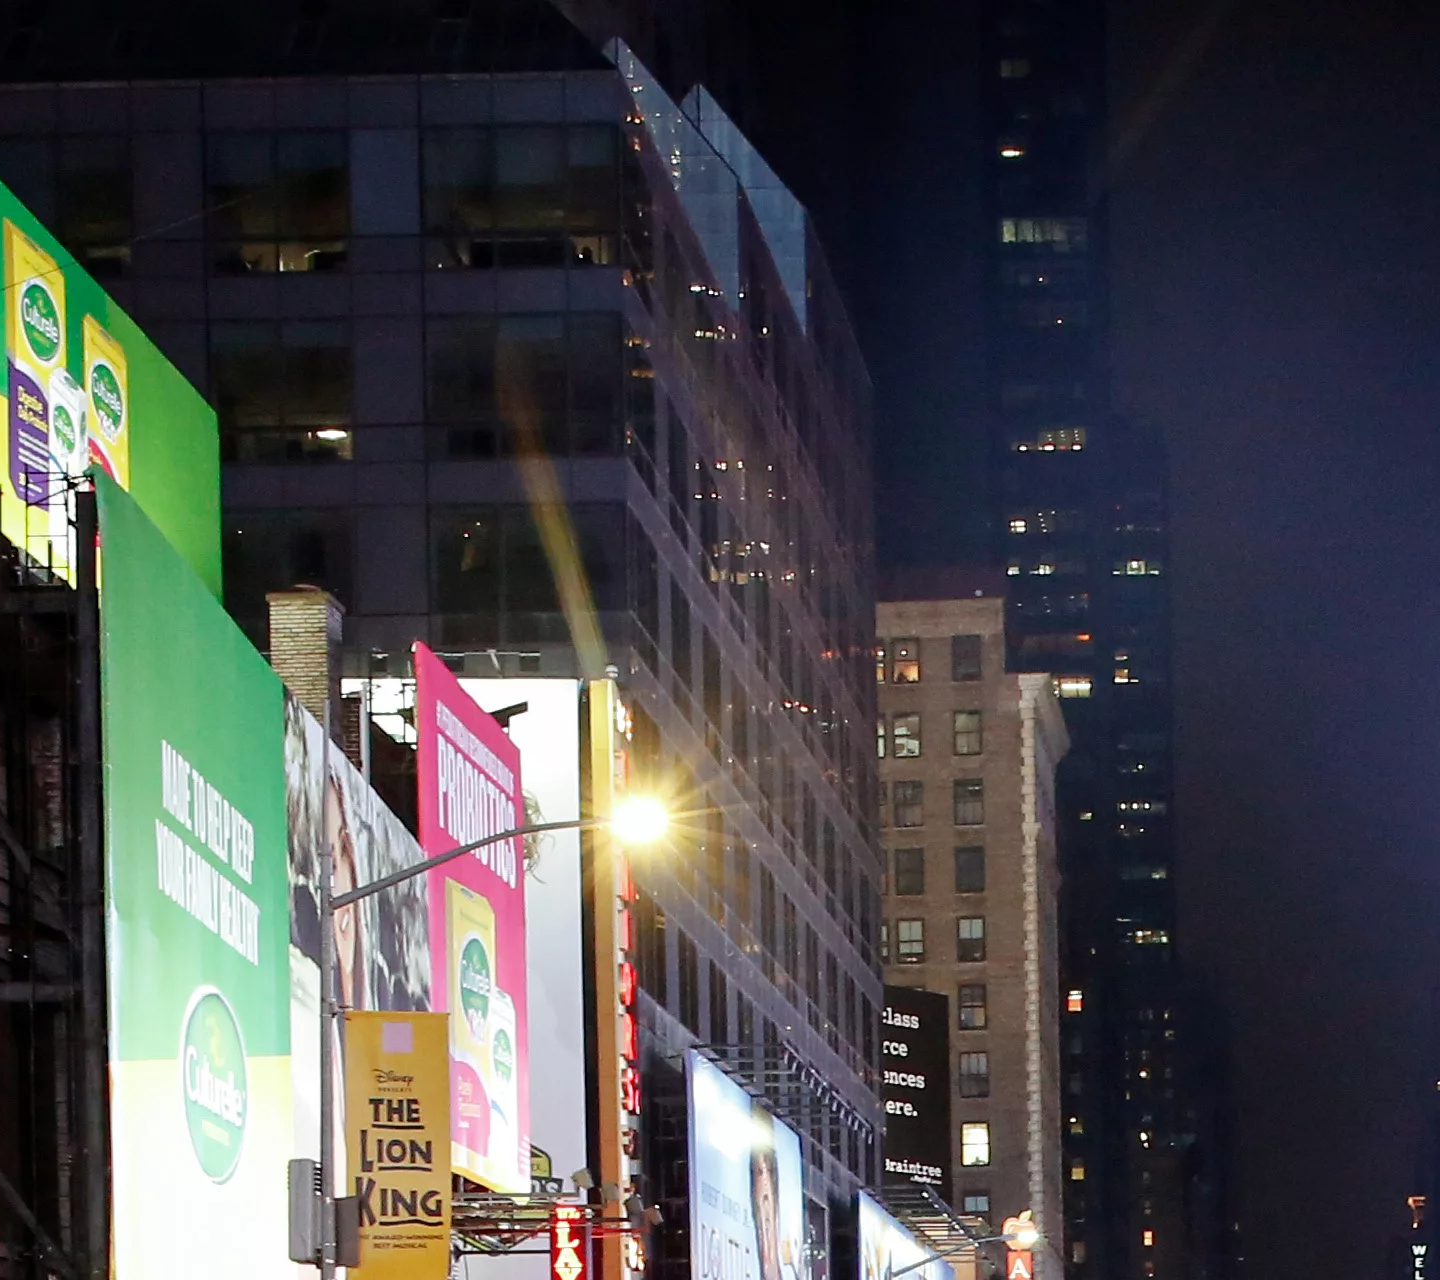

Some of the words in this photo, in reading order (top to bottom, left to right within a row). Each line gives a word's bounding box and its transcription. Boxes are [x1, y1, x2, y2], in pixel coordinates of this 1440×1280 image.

[371, 1068, 414, 1086] Disney
[369, 1098, 421, 1123] THE
[360, 1129, 433, 1172] LION
[355, 1176, 444, 1228] KING
